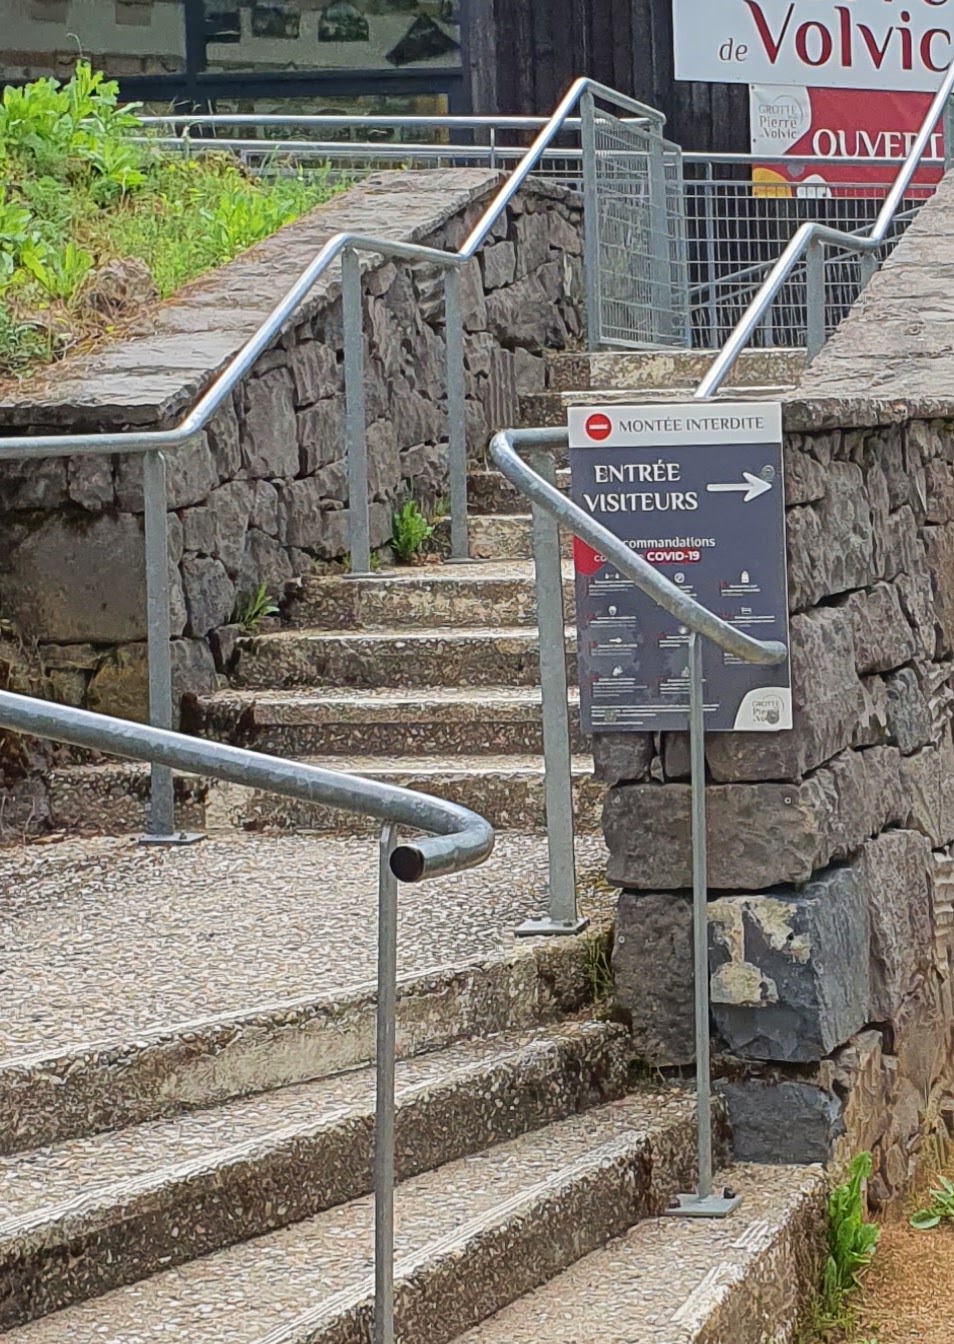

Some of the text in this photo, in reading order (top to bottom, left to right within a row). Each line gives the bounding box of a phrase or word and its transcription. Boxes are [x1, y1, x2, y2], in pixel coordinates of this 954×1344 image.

[718, 0, 952, 72] de Volvic
[760, 115, 797, 129] Pierre
[763, 127, 797, 139] Volvic
[619, 417, 765, 433] MONTÉE INTERDITE
[593, 459, 681, 483] ENTRÉE
[583, 492, 698, 512] VISITEURS
[623, 537, 716, 549] commandations
[646, 551, 700, 562] COVID-19
